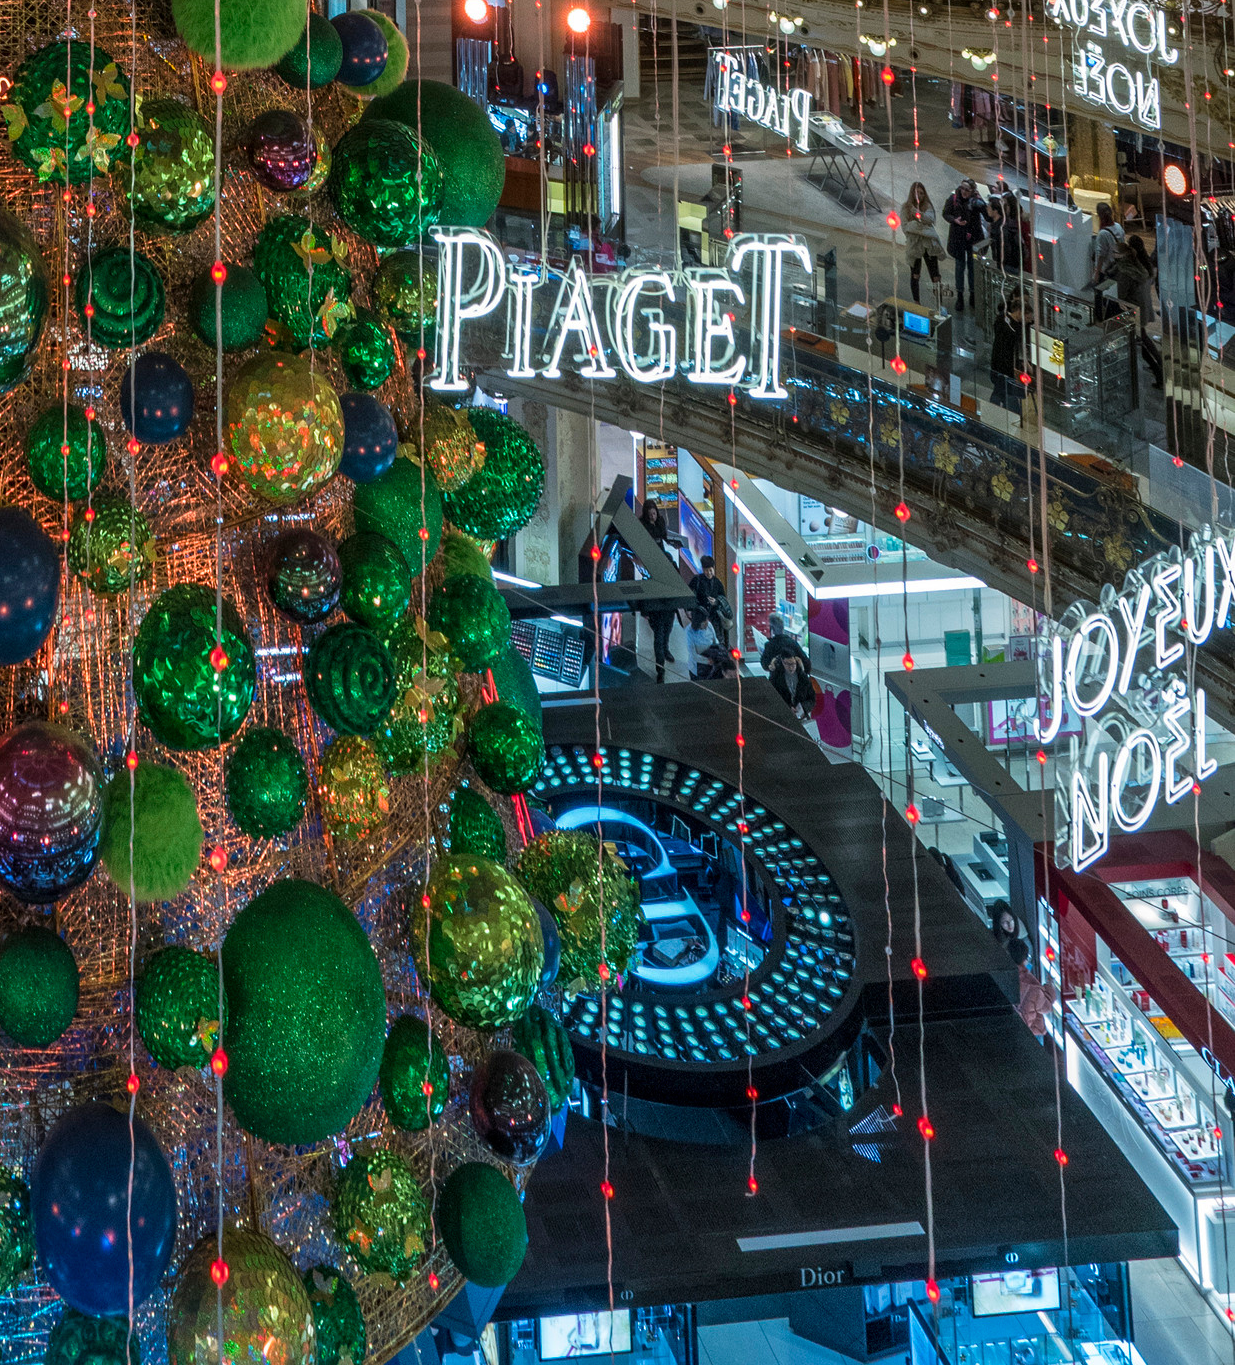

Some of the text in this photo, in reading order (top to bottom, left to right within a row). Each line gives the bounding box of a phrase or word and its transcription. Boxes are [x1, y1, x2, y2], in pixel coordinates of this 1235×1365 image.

[429, 229, 813, 401] PIAGET
[1072, 678, 1218, 874] NOËL
[1127, 885, 1189, 899] SOINS CORPS
[800, 1267, 845, 1287] Dior
